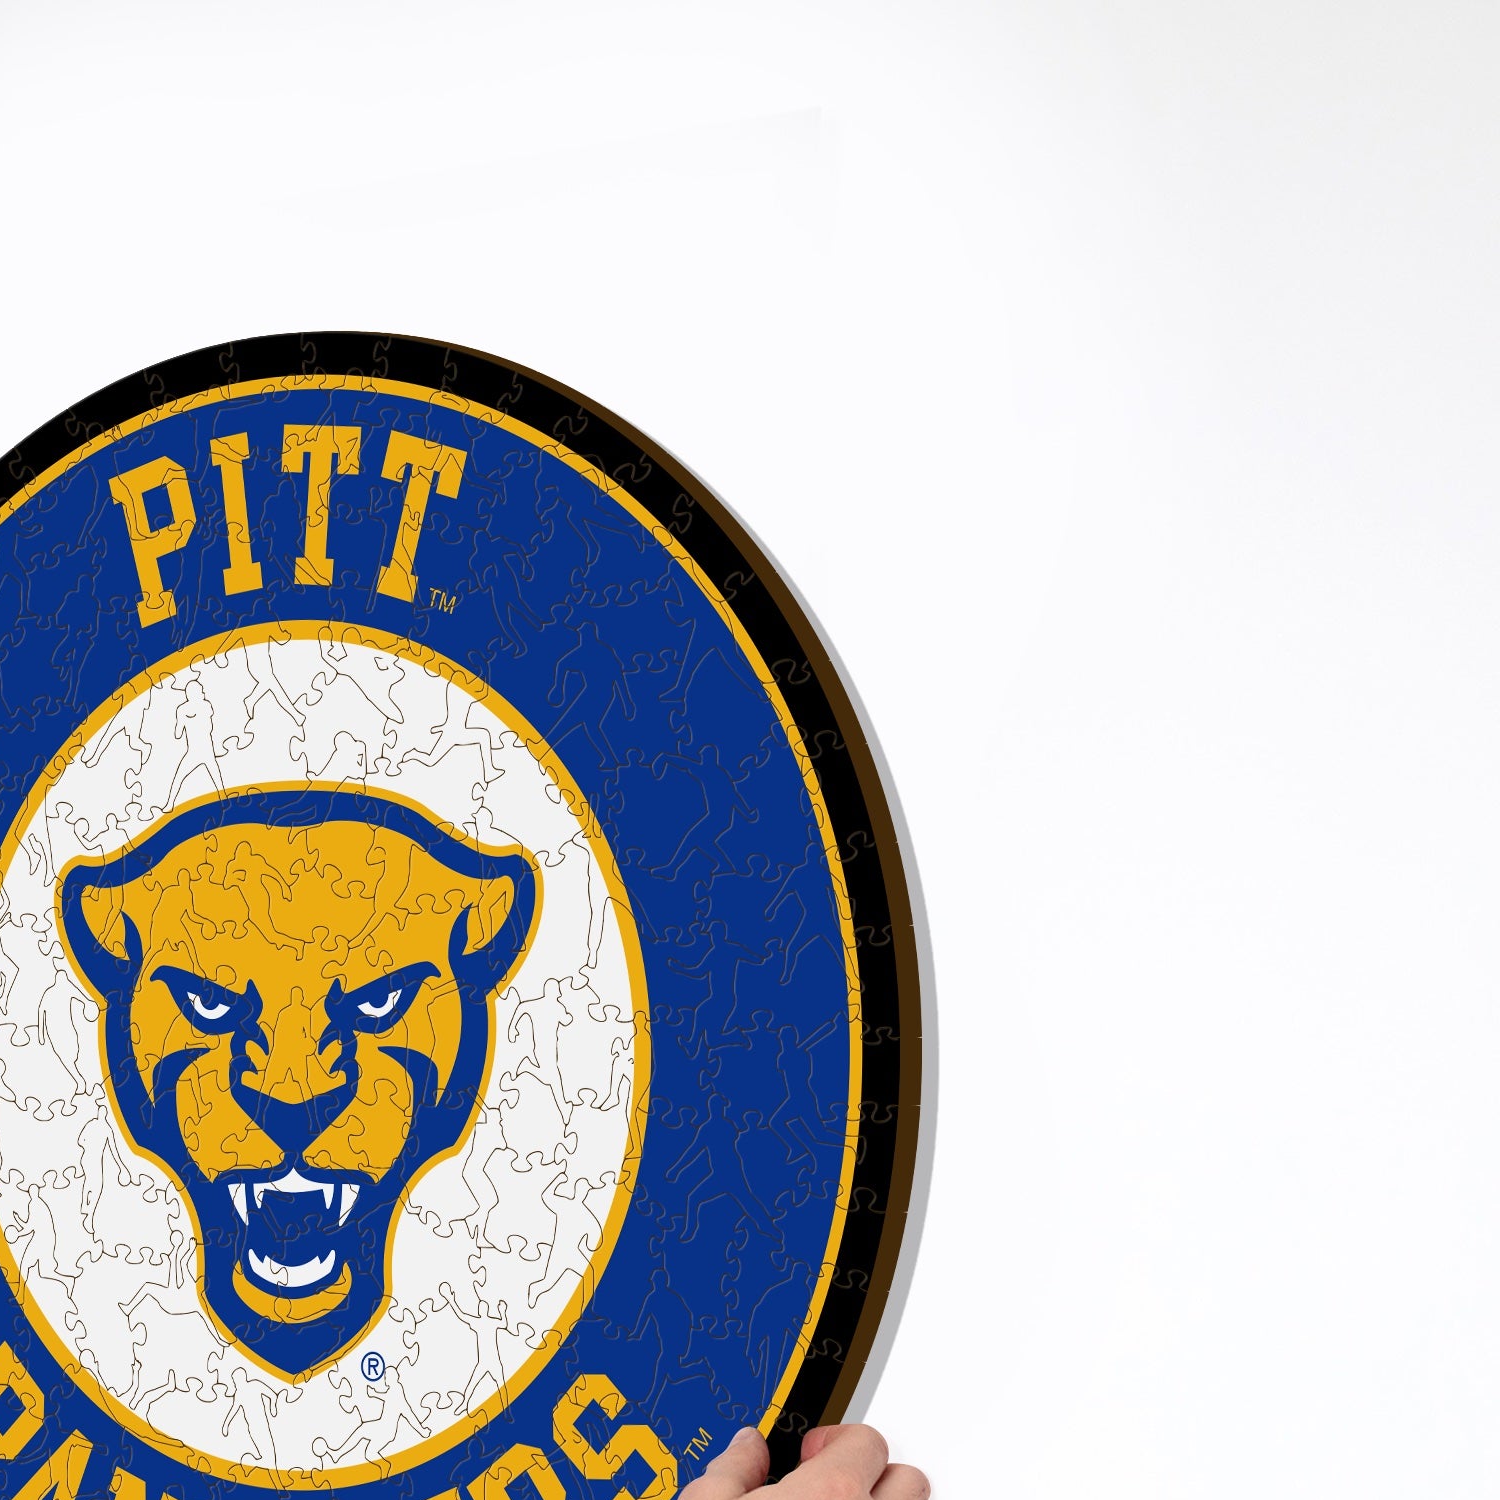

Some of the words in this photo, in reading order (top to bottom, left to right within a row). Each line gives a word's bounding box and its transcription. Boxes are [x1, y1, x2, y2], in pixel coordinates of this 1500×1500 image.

[108, 424, 468, 628] PITT
[429, 587, 457, 615] TM
[683, 1427, 713, 1461] TM
